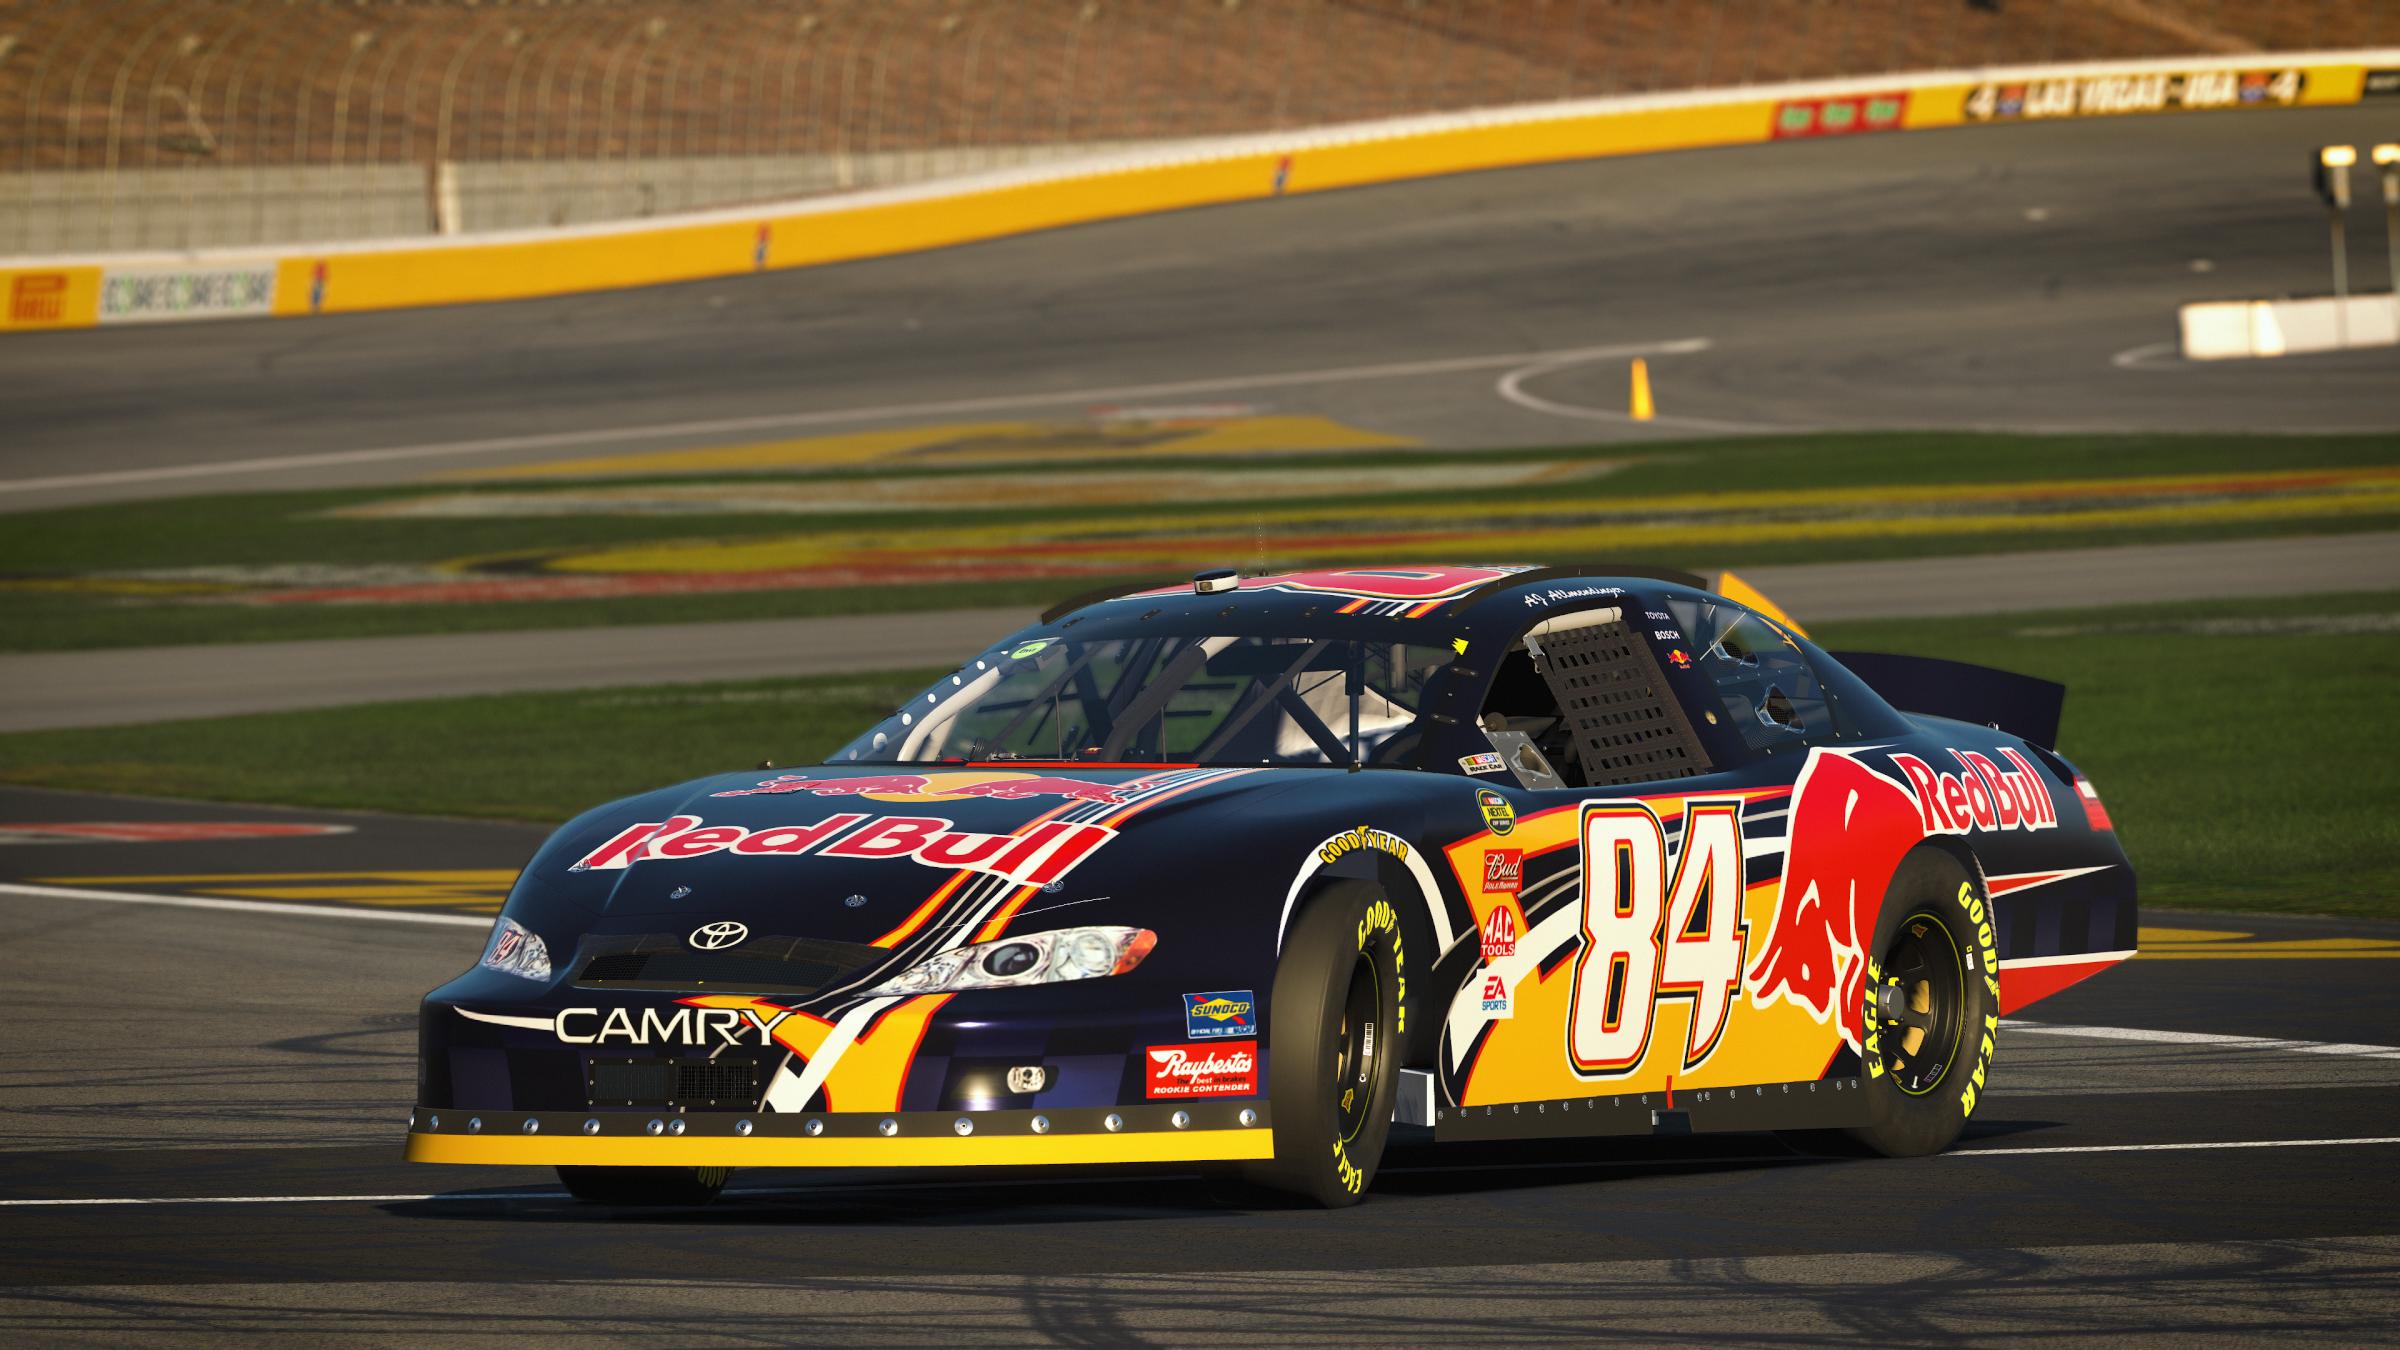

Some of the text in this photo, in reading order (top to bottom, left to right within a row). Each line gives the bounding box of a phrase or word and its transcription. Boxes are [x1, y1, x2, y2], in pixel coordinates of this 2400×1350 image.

[1644, 611, 1671, 620] TOYOTA
[1654, 630, 1681, 640] BOSCH
[1887, 747, 2058, 836] Red Bull
[569, 814, 1119, 887] Red Bull
[1318, 825, 1409, 864] GOODYEAR
[1485, 854, 1522, 881] Bud
[1483, 907, 1514, 944] MAC
[1566, 797, 1752, 1082] 84
[1481, 944, 1515, 956] TOOLS
[1483, 976, 1507, 1000] EA
[1194, 1003, 1248, 1015] SUNOCO
[1482, 1000, 1507, 1011] SPORTS
[1864, 955, 1886, 1079] EAGLE
[555, 1007, 796, 1046] CAMRY
[1150, 1049, 1253, 1085] Raybestos
[1153, 1083, 1250, 1094] ROOKIE CONTENDER
